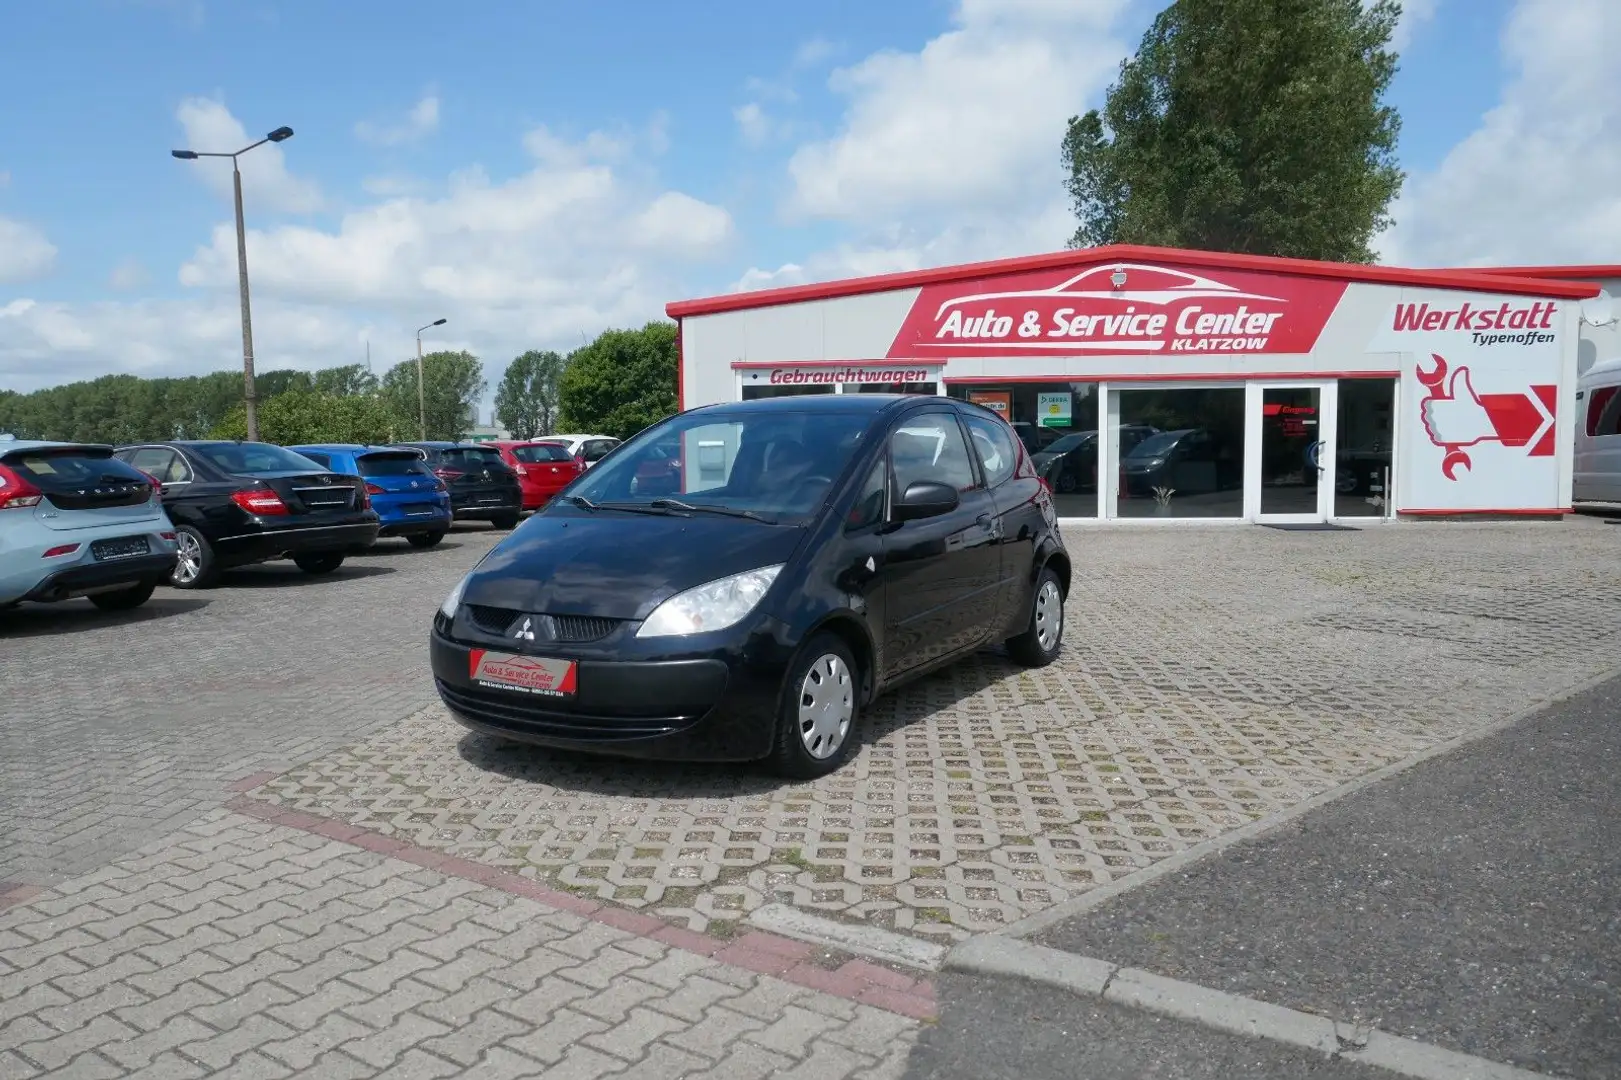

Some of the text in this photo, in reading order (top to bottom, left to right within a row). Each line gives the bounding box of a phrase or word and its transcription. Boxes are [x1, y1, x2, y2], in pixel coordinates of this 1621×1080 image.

[936, 306, 1284, 338] Auto & Service Center
[1393, 301, 1558, 332] Werkstatt
[1170, 337, 1269, 352] KLATZOW
[1472, 332, 1555, 346] Typenoffen
[770, 368, 927, 388] Gebrauchtwagen
[483, 664, 498, 674] Auto
[504, 667, 530, 679] Service
[531, 671, 556, 683] Center
